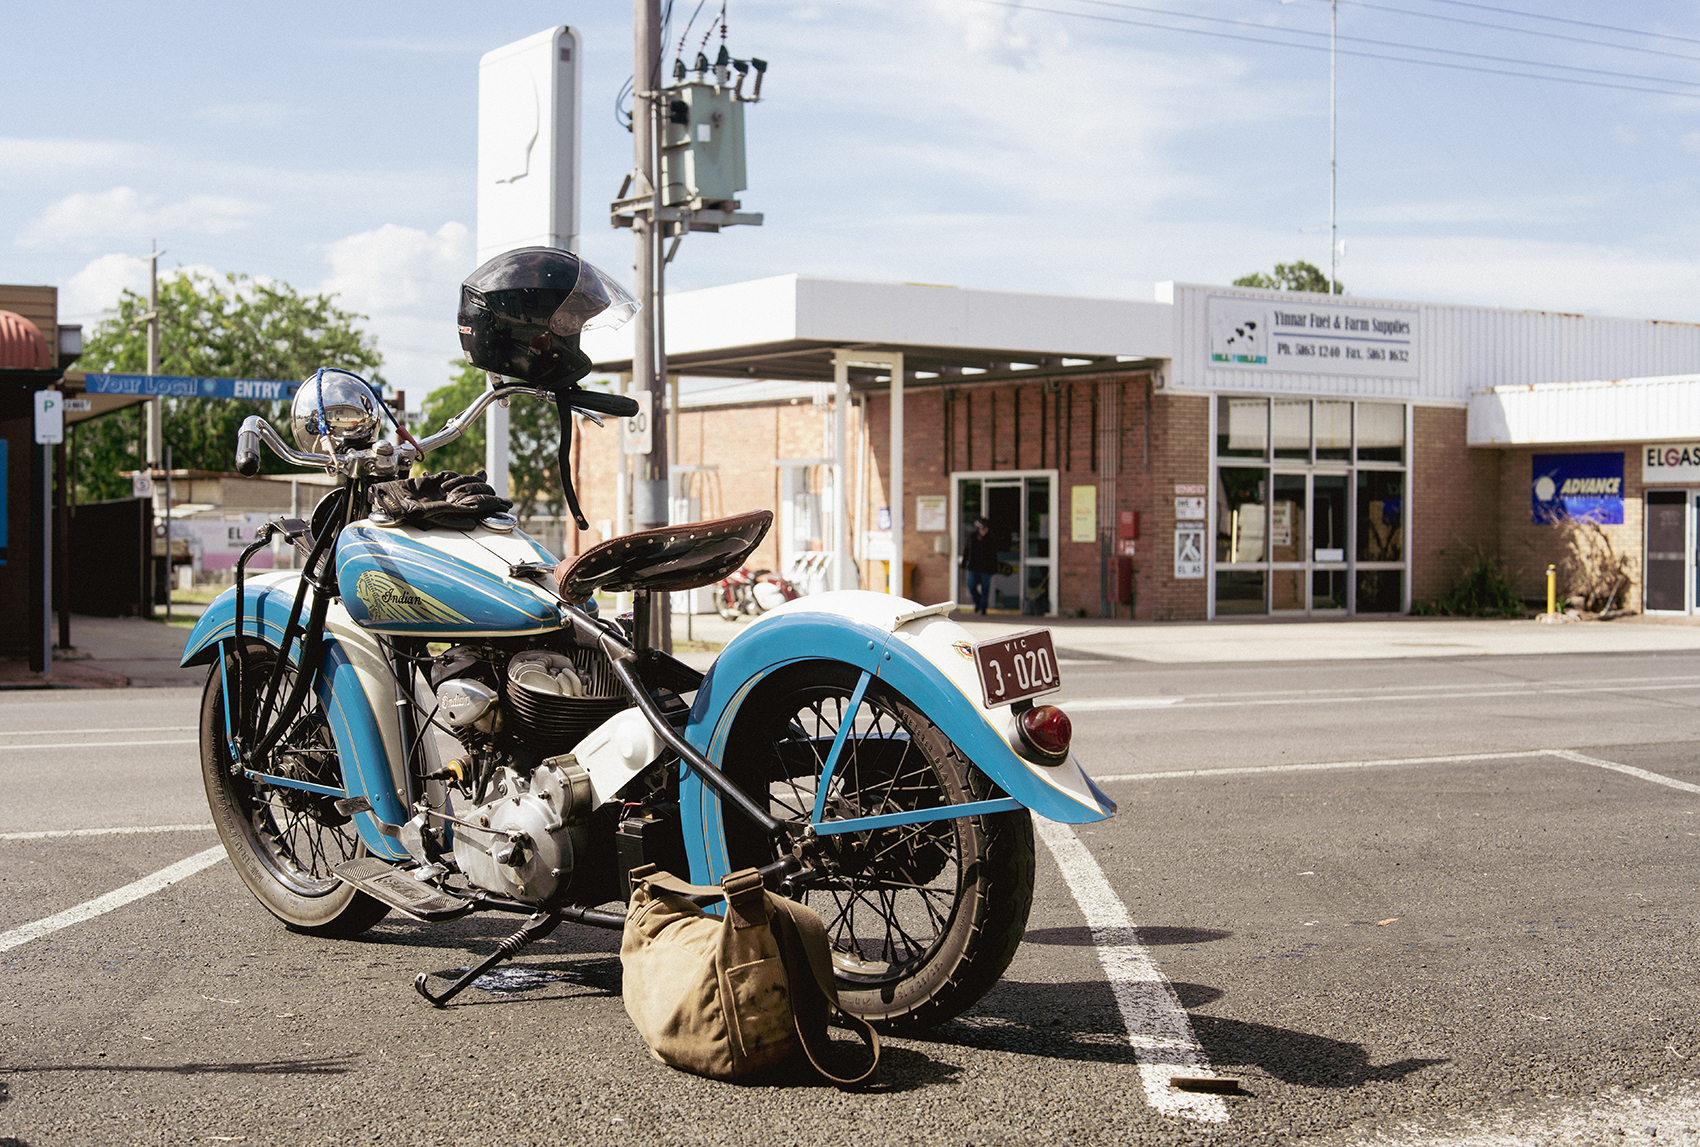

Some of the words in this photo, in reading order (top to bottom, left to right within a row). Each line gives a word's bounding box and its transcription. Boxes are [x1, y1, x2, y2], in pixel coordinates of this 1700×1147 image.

[1274, 310, 1307, 327] Yinnar
[1310, 313, 1331, 328] Fuel
[1334, 315, 1341, 329] &
[1345, 316, 1370, 331] Farm
[1372, 318, 1410, 335] Supplies
[1319, 345, 1341, 358] 1240
[94, 374, 142, 393] Your
[146, 376, 198, 396] Local
[234, 380, 282, 399] ENTRY
[44, 400, 55, 412] P
[629, 413, 647, 432] 60
[1647, 448, 1700, 467] ELGAS
[1560, 477, 1622, 494] ADVANCE
[381, 588, 422, 606] Indian
[1004, 639, 1027, 651] VIC
[441, 693, 470, 709] Indian
